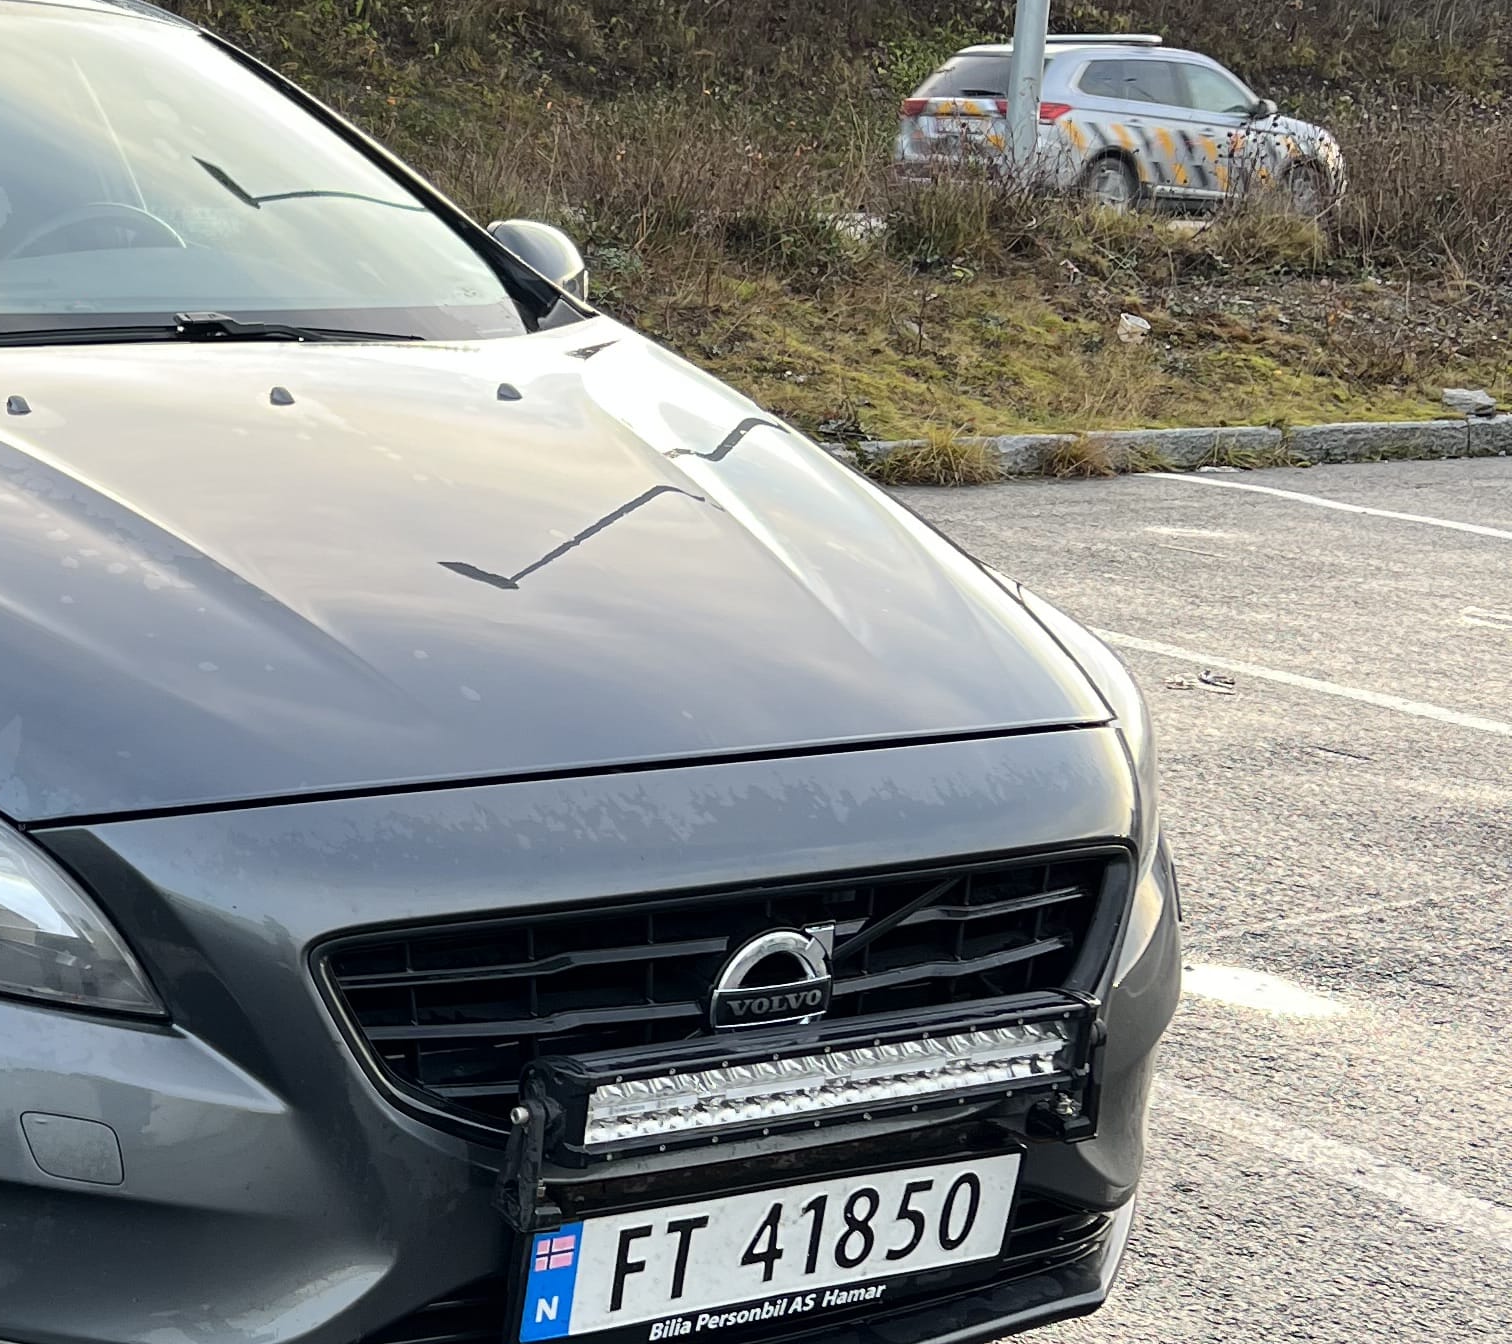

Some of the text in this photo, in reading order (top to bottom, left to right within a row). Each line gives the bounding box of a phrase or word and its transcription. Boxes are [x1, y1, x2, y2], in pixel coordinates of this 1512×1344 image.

[727, 989, 822, 1016] VOLVO
[609, 1172, 981, 1312] FT 41850
[535, 1295, 559, 1323] N
[649, 1284, 886, 1341] Bilia Personbil AS Hamar
